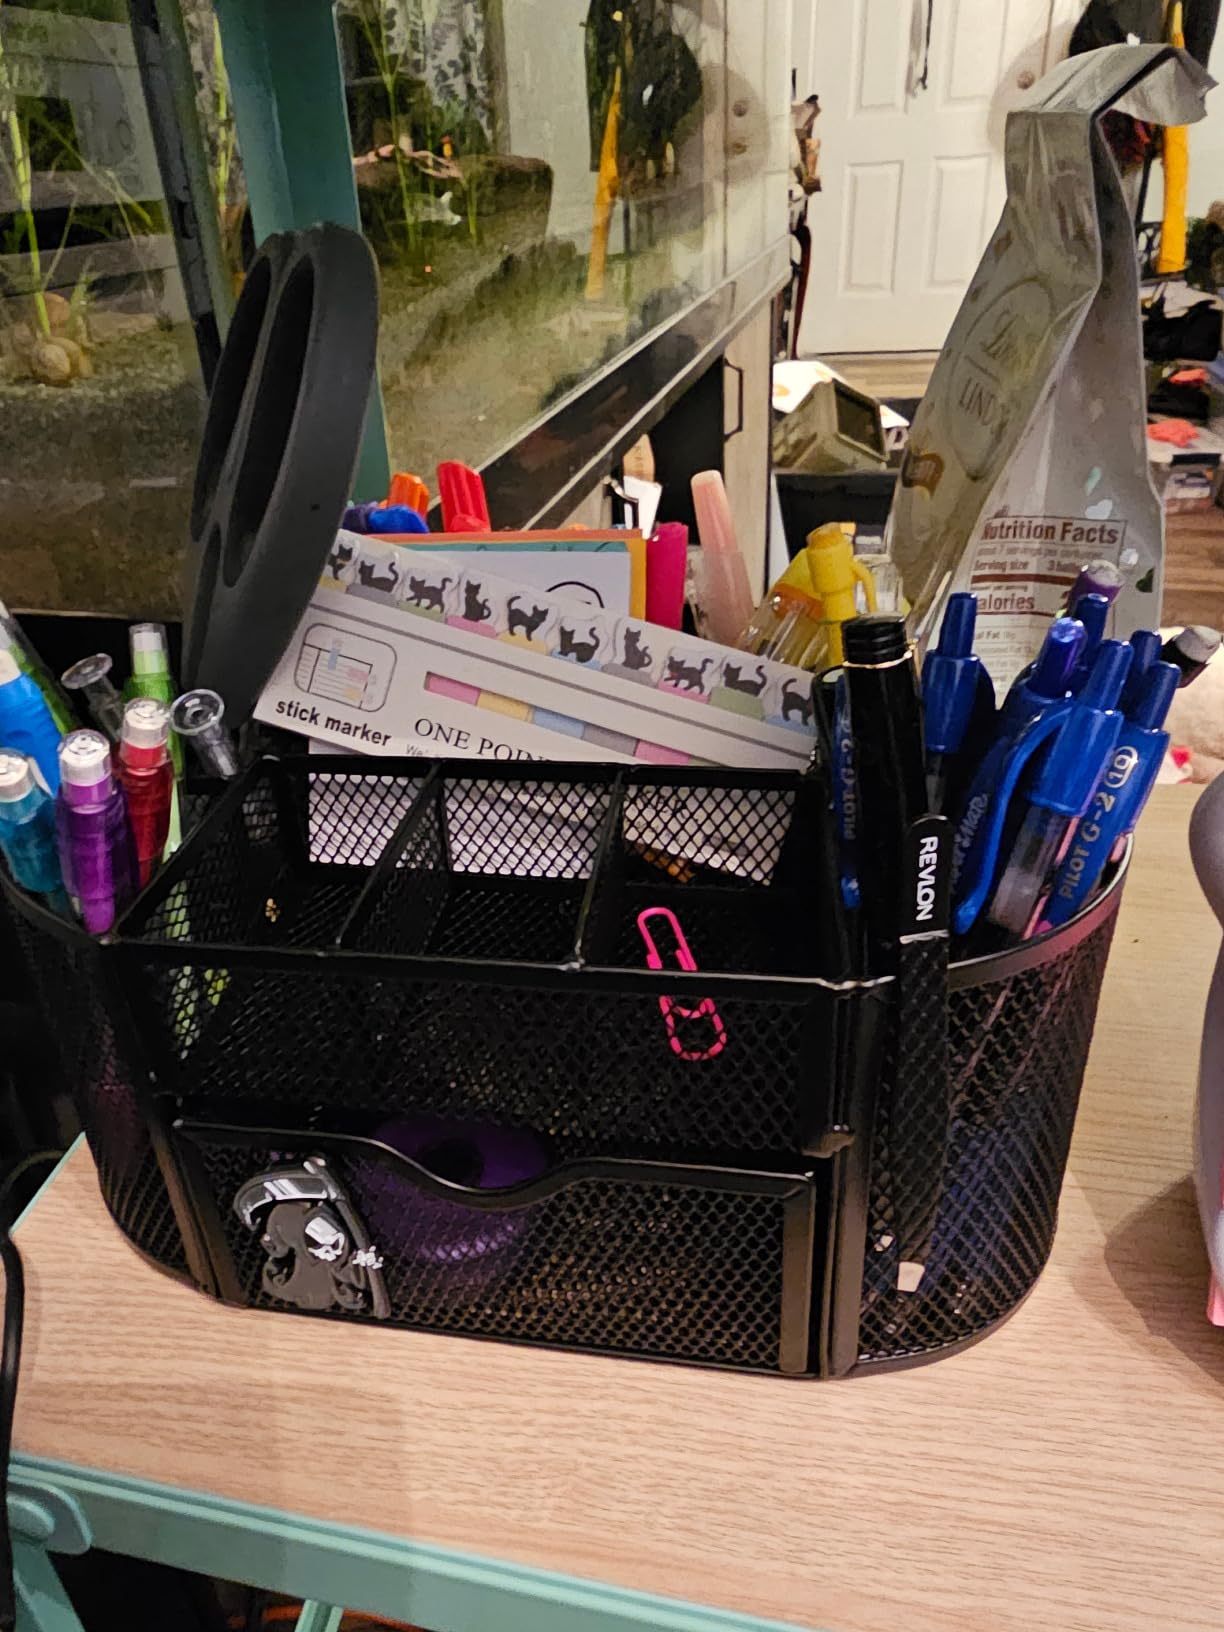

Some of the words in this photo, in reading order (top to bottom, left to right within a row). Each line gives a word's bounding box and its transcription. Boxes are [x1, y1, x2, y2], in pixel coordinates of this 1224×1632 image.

[980, 520, 1056, 541] Nutrition
[1060, 521, 1119, 544] Facts
[1010, 560, 1029, 570] size
[977, 593, 1035, 610] alories
[275, 700, 320, 726] stick
[324, 716, 392, 747] marker
[414, 718, 471, 750] ONE
[1058, 844, 1090, 899] PILOT
[1081, 791, 1116, 842] G-2
[1107, 752, 1133, 780] 10
[915, 835, 939, 921] REVLON
